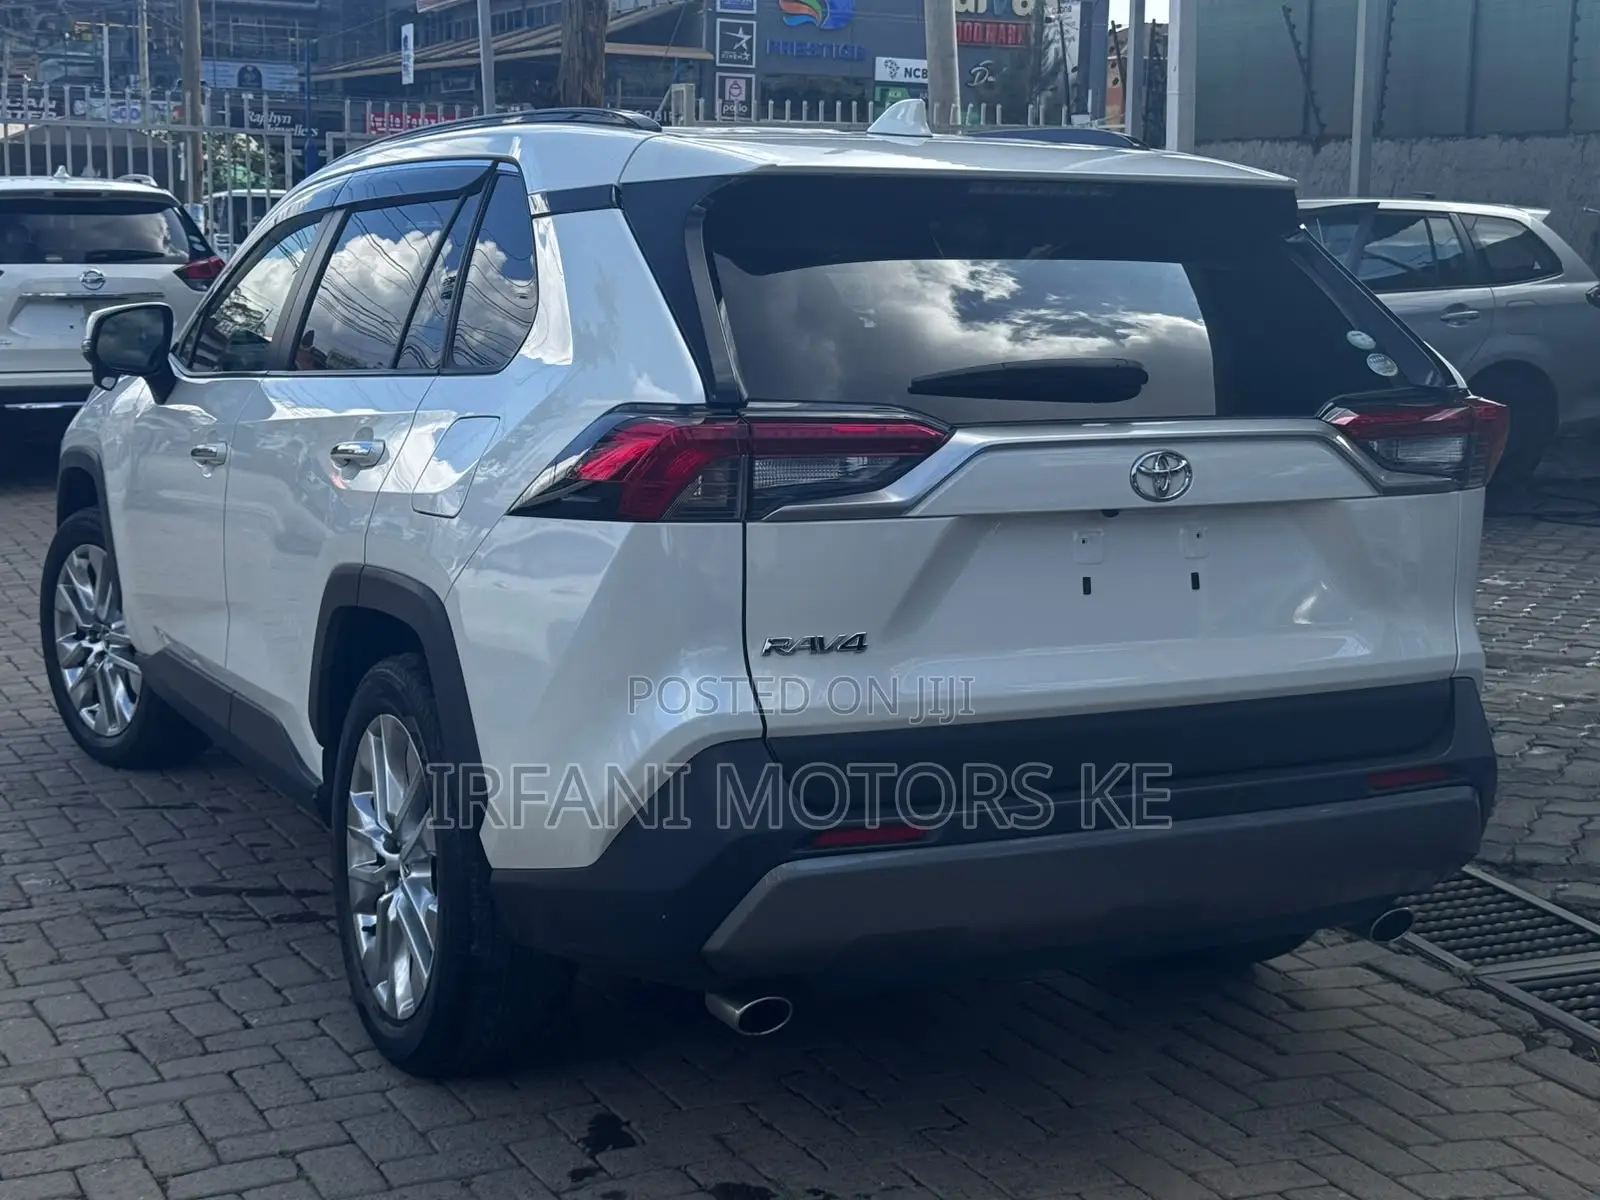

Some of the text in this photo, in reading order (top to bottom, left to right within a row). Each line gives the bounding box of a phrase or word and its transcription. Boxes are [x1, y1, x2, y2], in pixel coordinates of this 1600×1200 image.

[766, 39, 869, 61] PRESTIGE
[904, 67, 928, 79] NCB
[762, 632, 868, 656] RAV4
